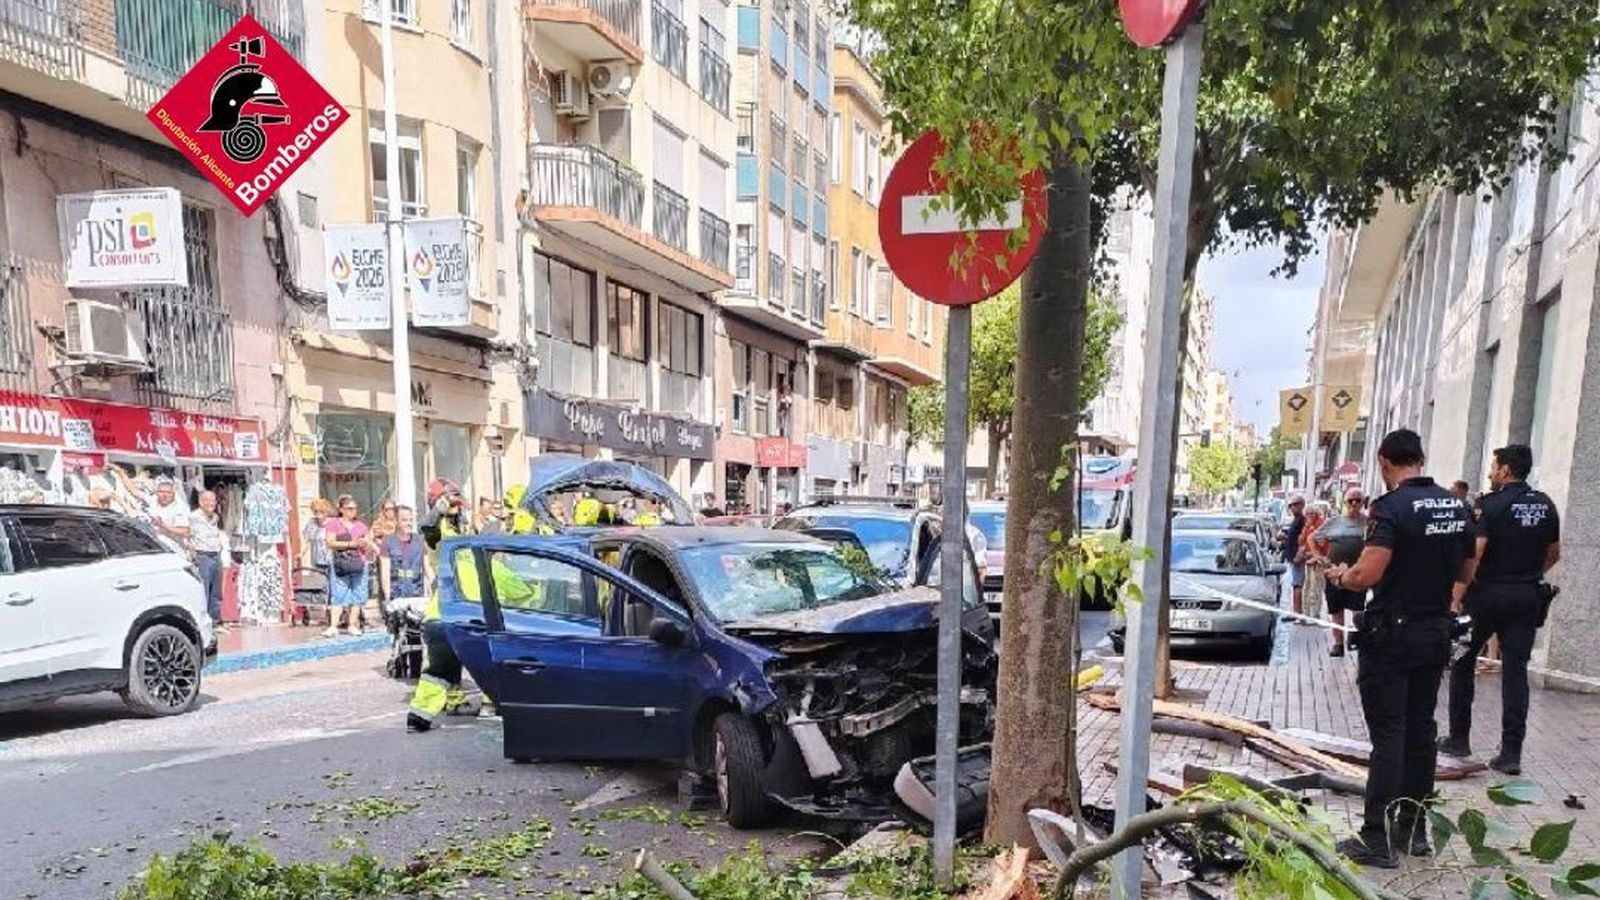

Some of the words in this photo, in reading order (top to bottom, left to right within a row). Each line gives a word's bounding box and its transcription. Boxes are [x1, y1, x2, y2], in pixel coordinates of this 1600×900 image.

[85, 207, 125, 268] psi
[352, 249, 385, 266] ELCHE
[355, 267, 385, 288] 2026
